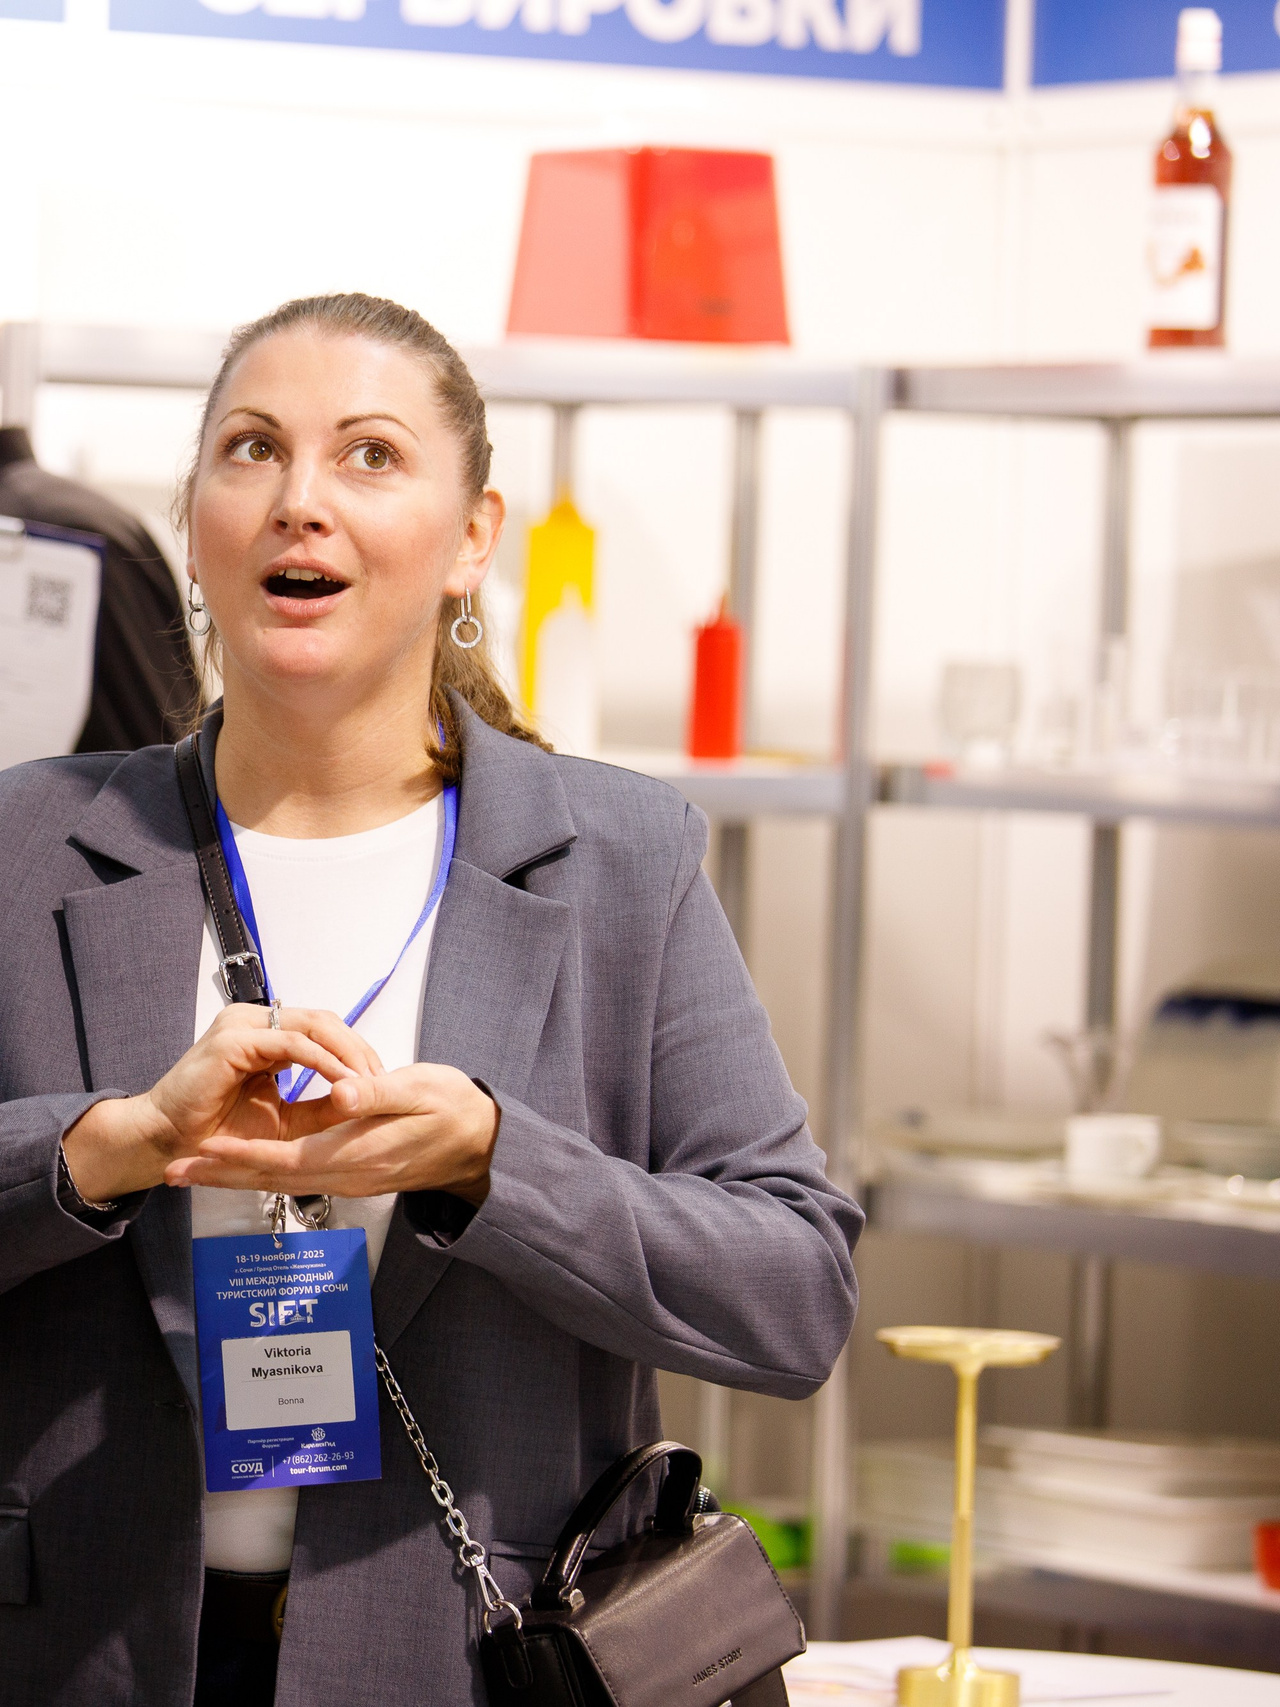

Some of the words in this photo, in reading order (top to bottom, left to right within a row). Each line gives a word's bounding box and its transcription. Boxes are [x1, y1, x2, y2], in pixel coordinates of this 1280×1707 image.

[235, 1254, 260, 1264] 18-19
[262, 1252, 295, 1263] ноября
[303, 1249, 325, 1259] 2025
[229, 1277, 244, 1287] VIII
[245, 1270, 334, 1286] МЕЖДУНАРОДНЫЙ
[216, 1286, 277, 1301] ТУРИСТСКИЙ
[278, 1285, 313, 1296] ФОРУМ
[314, 1284, 321, 1294] В
[322, 1283, 349, 1293] СОЧИ
[264, 1345, 312, 1358] Viktoria
[251, 1364, 324, 1380] Myasnikova
[278, 1397, 305, 1406] Bonna
[282, 1456, 292, 1465] +7
[292, 1454, 313, 1466] (862)
[314, 1451, 355, 1463] 262-26-93
[231, 1462, 264, 1474] СОУД
[289, 1464, 348, 1475] tour-forum.com
[692, 1664, 718, 1686] JANES
[718, 1647, 743, 1669] STORY
